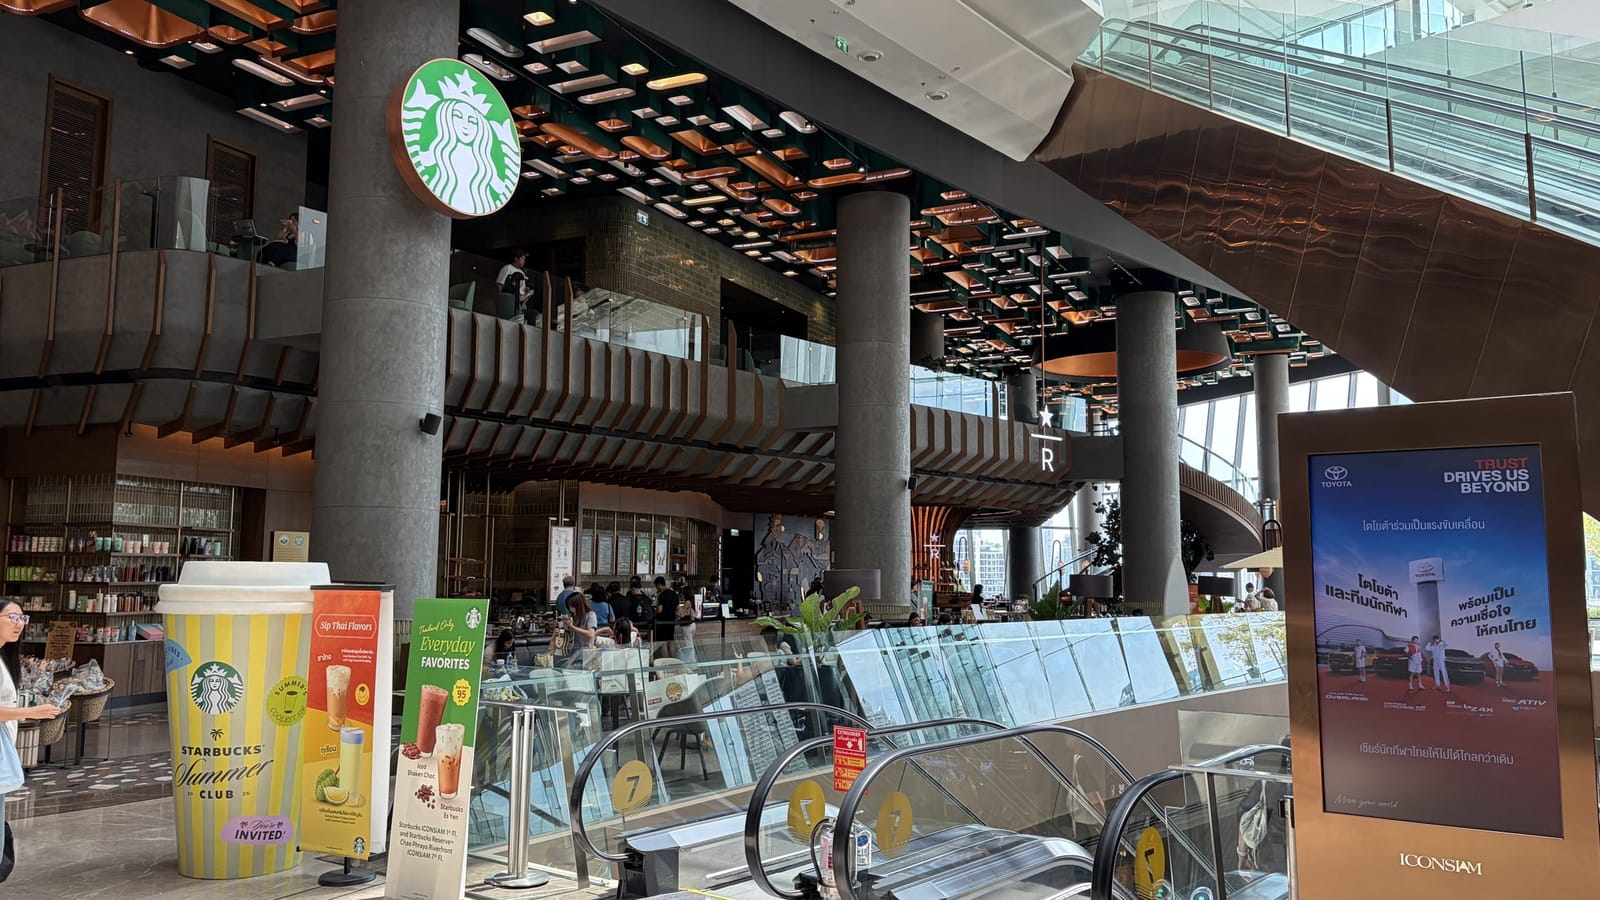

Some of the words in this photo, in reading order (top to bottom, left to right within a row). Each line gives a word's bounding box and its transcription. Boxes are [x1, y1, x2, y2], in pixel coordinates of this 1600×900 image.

[1042, 447, 1054, 472] R
[1475, 458, 1529, 470] TRUST
[1443, 470, 1502, 483] DRIVES
[1506, 469, 1530, 481] US
[1460, 481, 1530, 494] BEYOND
[1362, 516, 1486, 531] โตโยต้าร่วมเป็นแรงขับเคลื่อน
[1357, 573, 1399, 600] โตโยต้า
[1325, 584, 1408, 619] และทีมนักกีฬา
[1458, 585, 1515, 611] พร้อมเป็น
[1450, 604, 1512, 628] ความเชื่อใจ
[320, 621, 331, 631] Sip
[332, 621, 348, 630] Thai
[348, 621, 373, 631] Flavors
[1476, 617, 1537, 637] ให้คนไทย
[420, 636, 475, 656] Everyday
[421, 657, 470, 670] FAVORITES
[457, 690, 466, 698] 95
[181, 745, 262, 757] STARBUCKS
[1359, 743, 1514, 765] เชียร์นักกีฬาไทยให้ไปได้ไกลกว่าเดิม
[174, 758, 274, 788] Summer
[199, 790, 234, 799] CLUB
[626, 775, 641, 803] 7
[440, 803, 464, 812] Starbucks
[399, 821, 421, 830] Starbucks
[421, 825, 446, 835] ICONSIAM
[235, 830, 286, 841] INVITED!
[409, 832, 431, 841] Starbucks
[400, 839, 411, 847] Chao
[412, 841, 428, 850] Phraya
[429, 844, 453, 854] Riverfront
[407, 849, 431, 858] ICONSIAM
[1400, 852, 1483, 875] ICONSIAM
